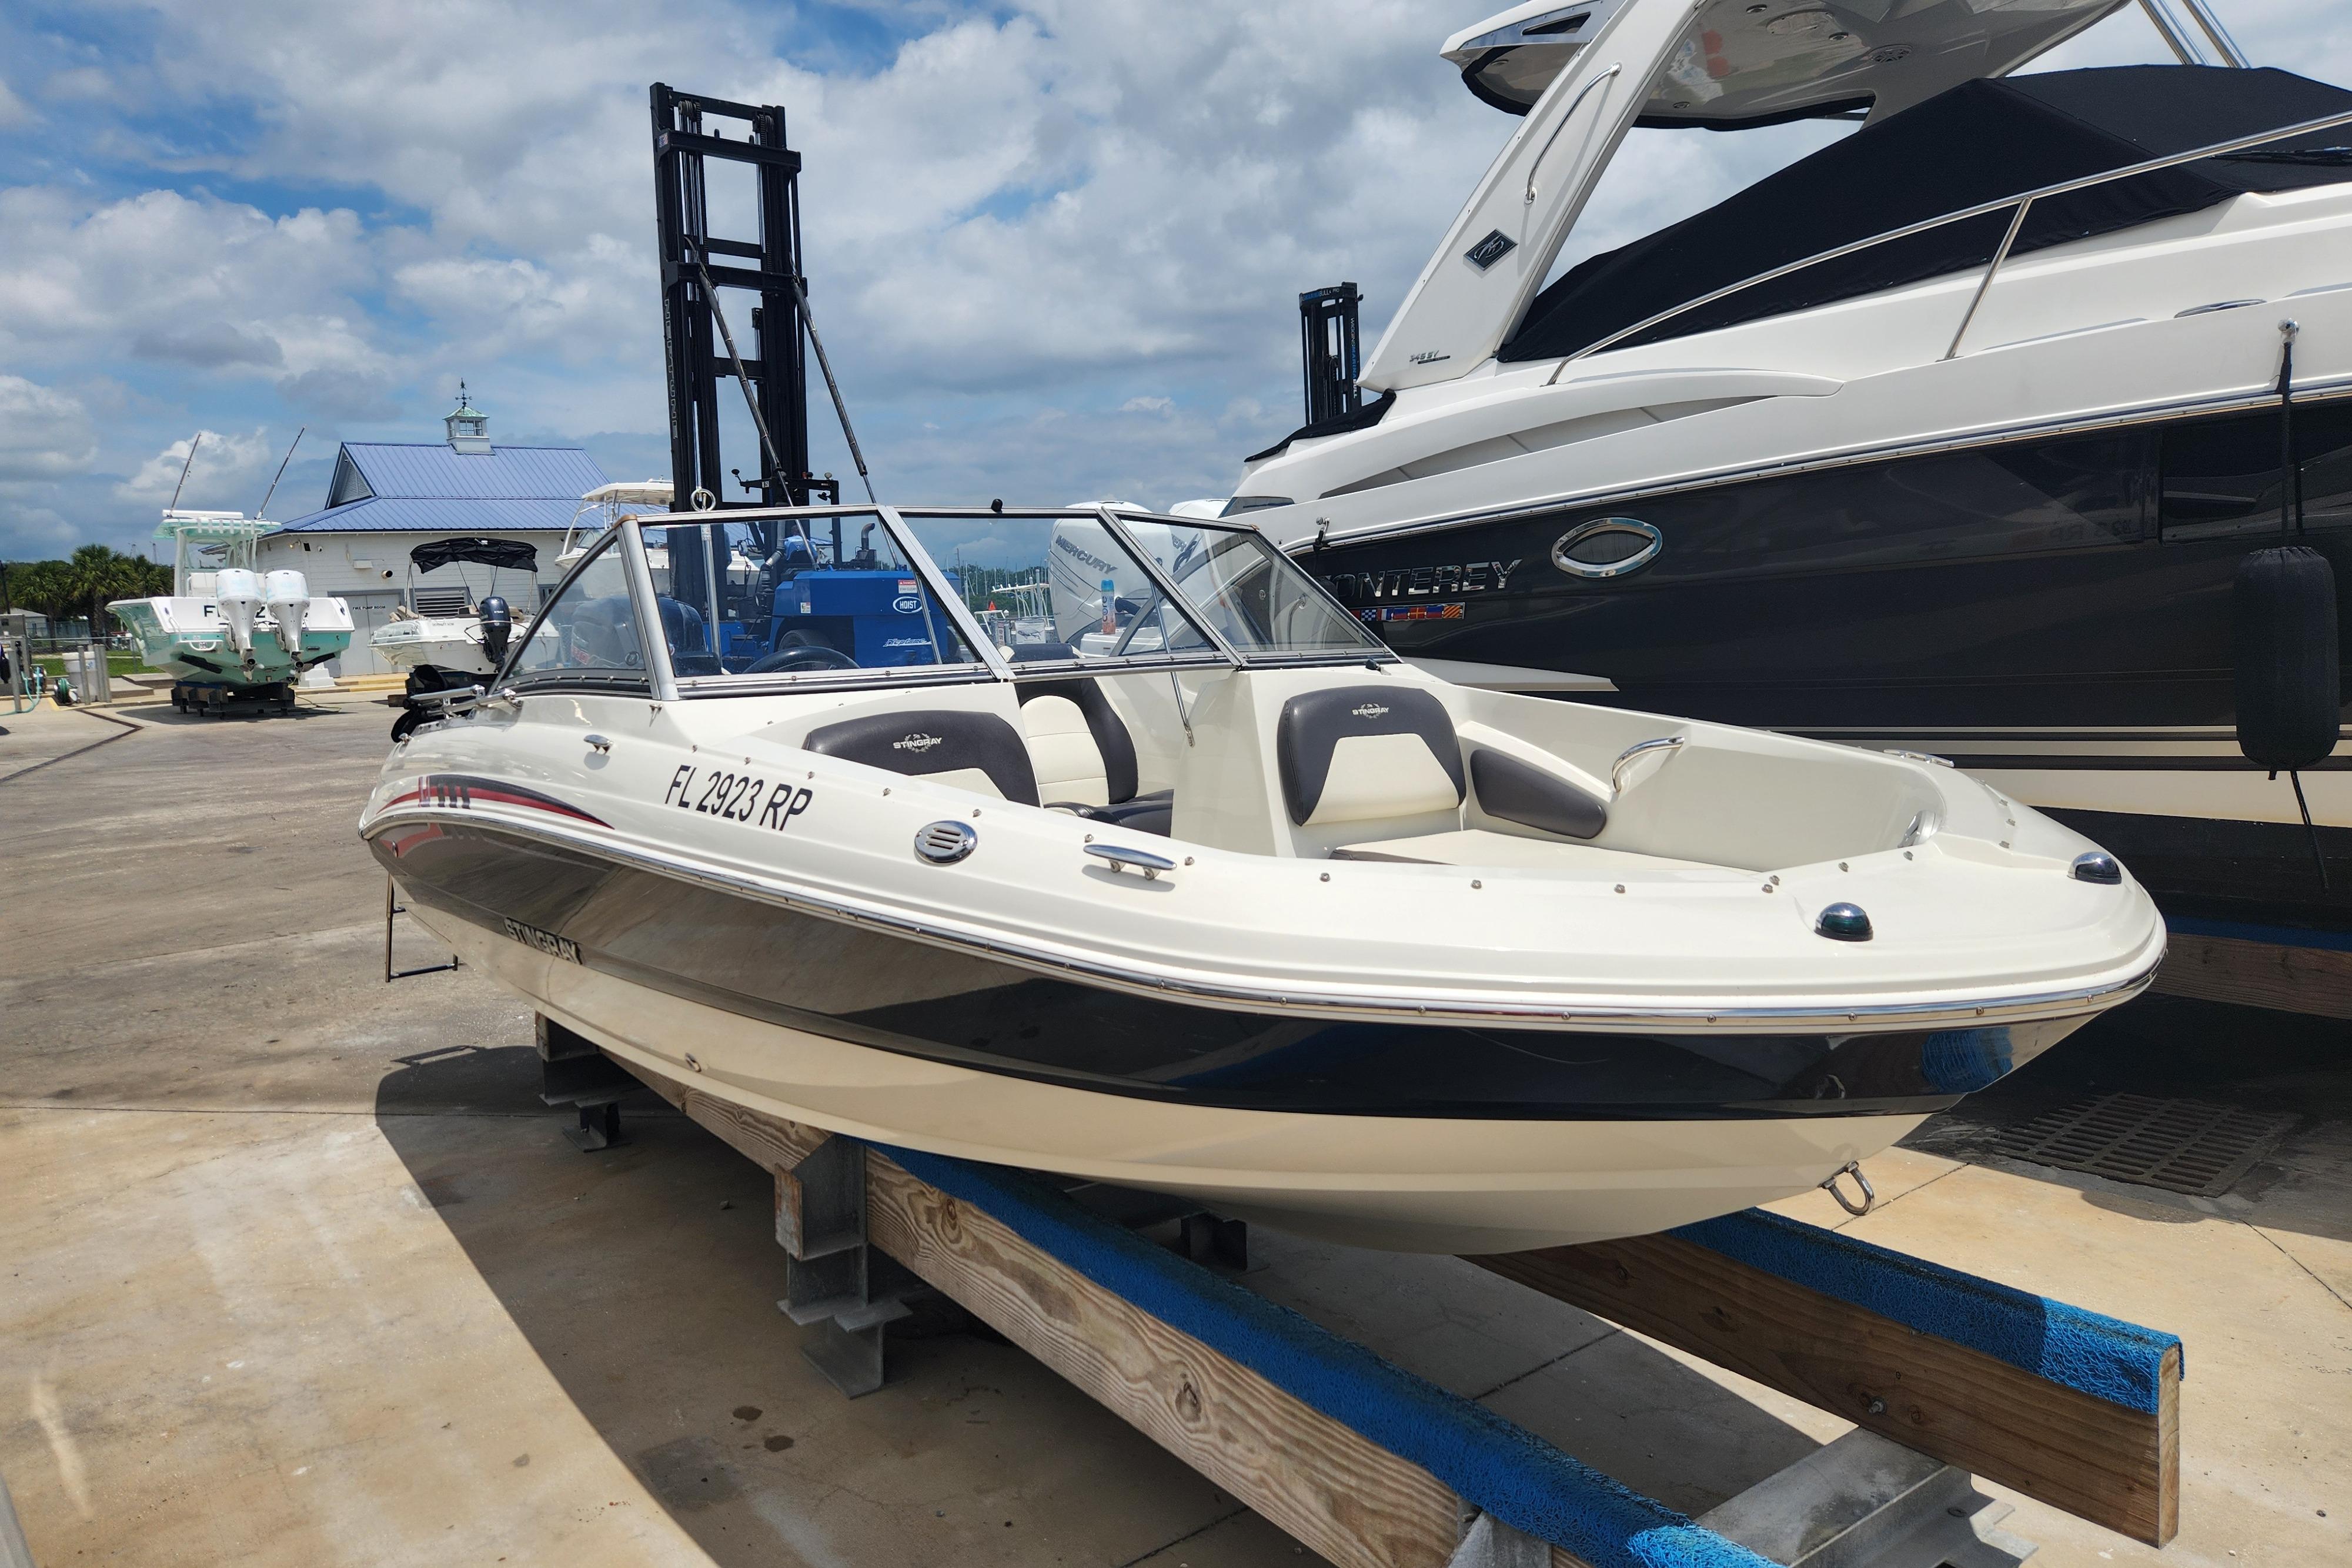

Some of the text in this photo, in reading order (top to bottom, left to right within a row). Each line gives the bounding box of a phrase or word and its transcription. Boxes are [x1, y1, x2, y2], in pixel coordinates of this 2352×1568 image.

[664, 298, 678, 440] NEPTUNE
[1055, 534, 1118, 574] MERCURY
[1328, 559, 1523, 599] ONTEREY
[900, 600, 917, 609] HOIST
[884, 638, 928, 647] Neptune
[893, 737, 942, 749] STINGRAY
[664, 764, 813, 831] FL 2923 RP
[503, 917, 583, 965] STINGRAY
